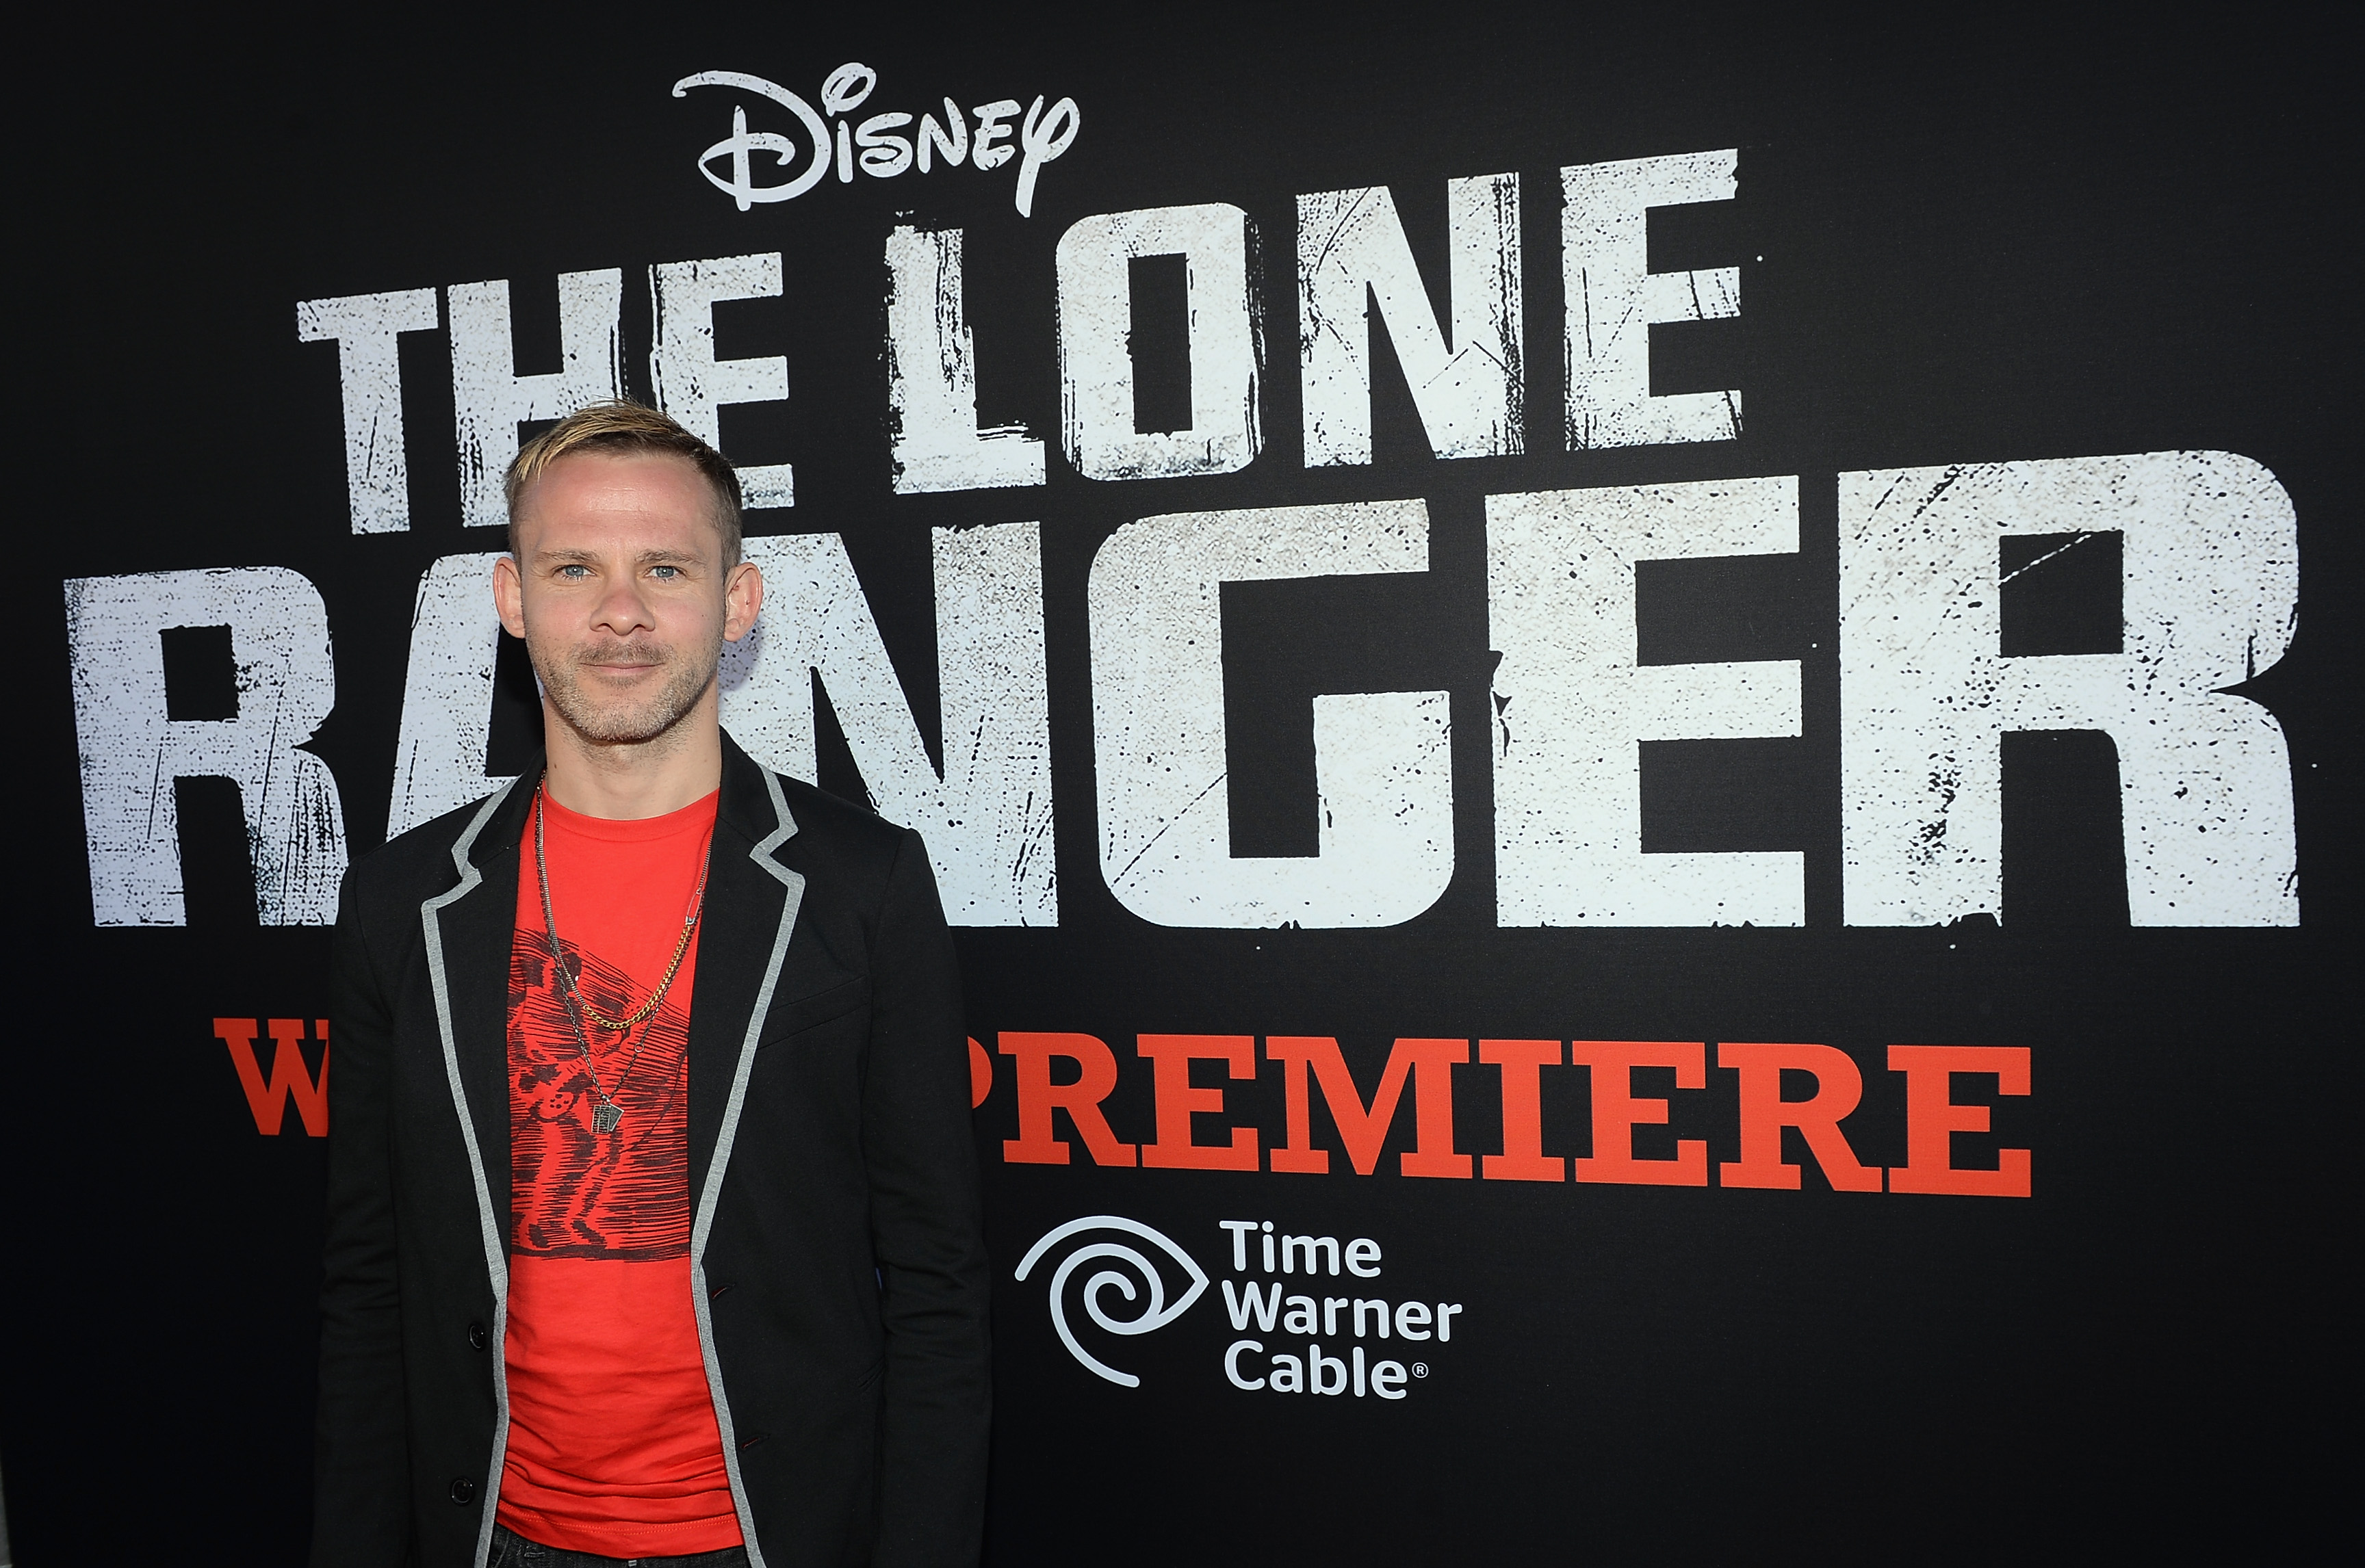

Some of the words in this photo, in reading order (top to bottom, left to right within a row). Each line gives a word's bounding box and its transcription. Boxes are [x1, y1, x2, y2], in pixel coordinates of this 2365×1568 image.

[296, 251, 795, 536] THE
[880, 148, 1743, 494] LONE
[966, 1031, 2034, 1199] REMIERE
[1219, 1220, 1382, 1278] Time
[1221, 1279, 1463, 1342] Warner
